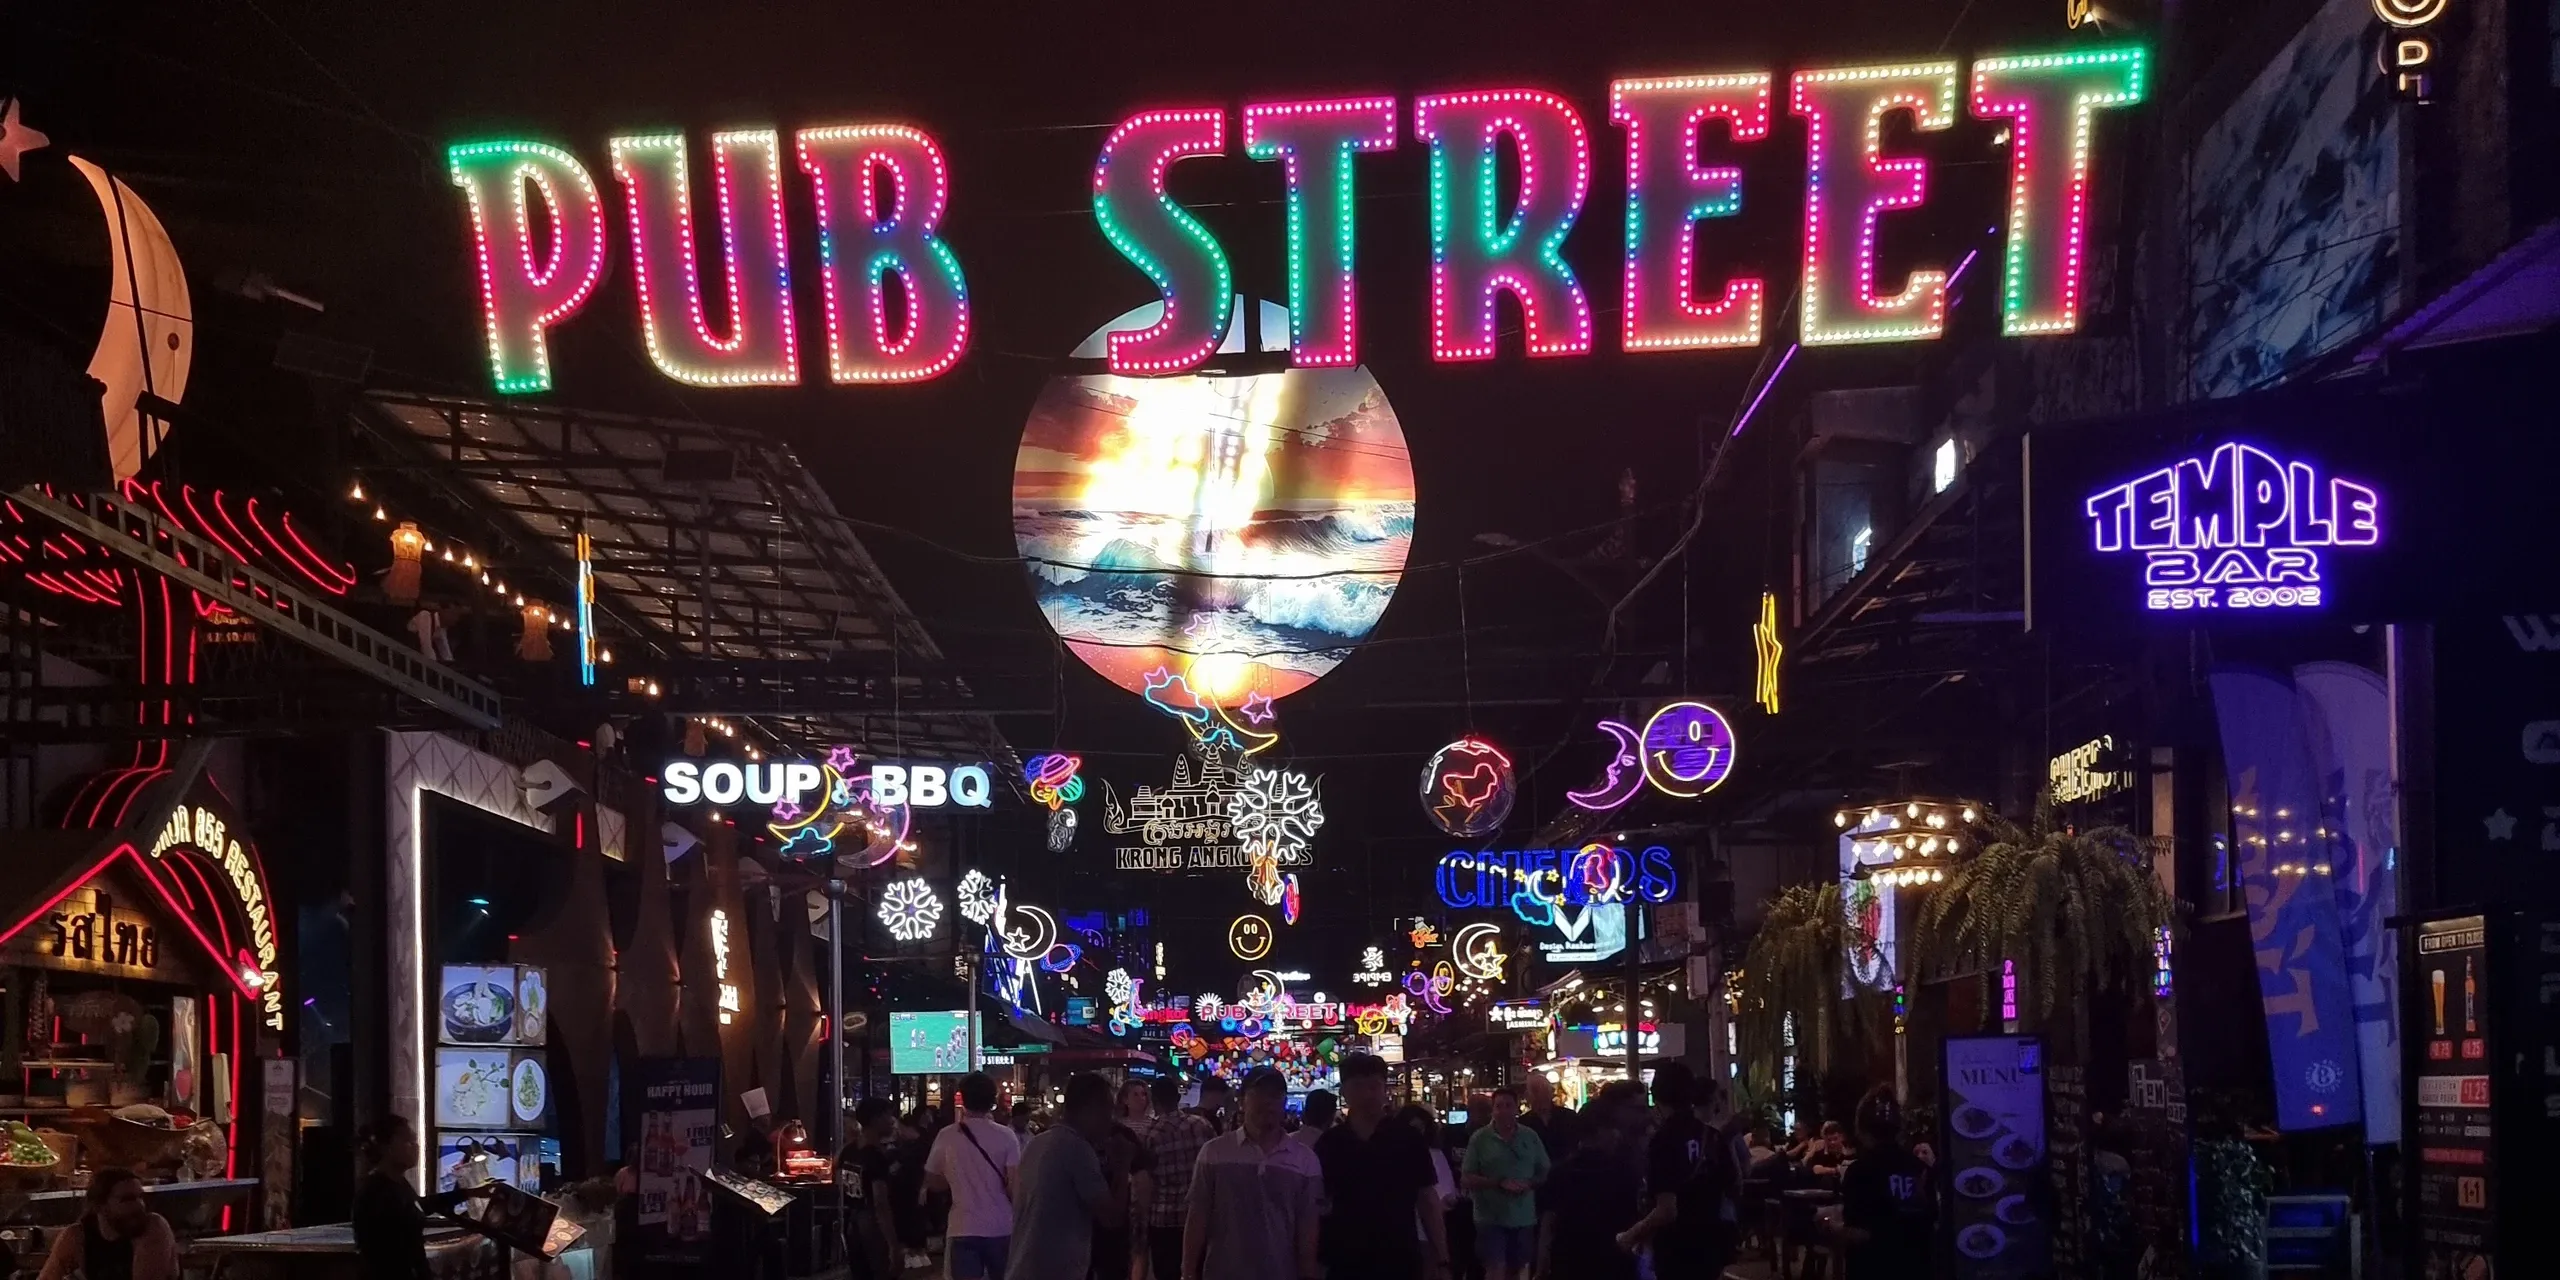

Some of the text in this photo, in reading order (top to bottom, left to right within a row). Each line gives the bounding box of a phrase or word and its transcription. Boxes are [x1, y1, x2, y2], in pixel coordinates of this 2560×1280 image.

[449, 47, 2147, 394] PUB STREET
[2087, 442, 2377, 551] TEMPLE
[2146, 549, 2320, 585] BAR
[2148, 587, 2320, 609] EST. 2002
[664, 761, 821, 805] SOUP
[871, 764, 993, 809] BBQ
[1116, 847, 1181, 869] KRONG
[50, 889, 158, 968] รสไทย
[195, 806, 226, 859] 855
[224, 839, 283, 1031] RESTAURANT
[1201, 1004, 1246, 1021] PUB
[647, 1083, 713, 1098] HAPPY HOUR
[1960, 1069, 2024, 1085] MENU
